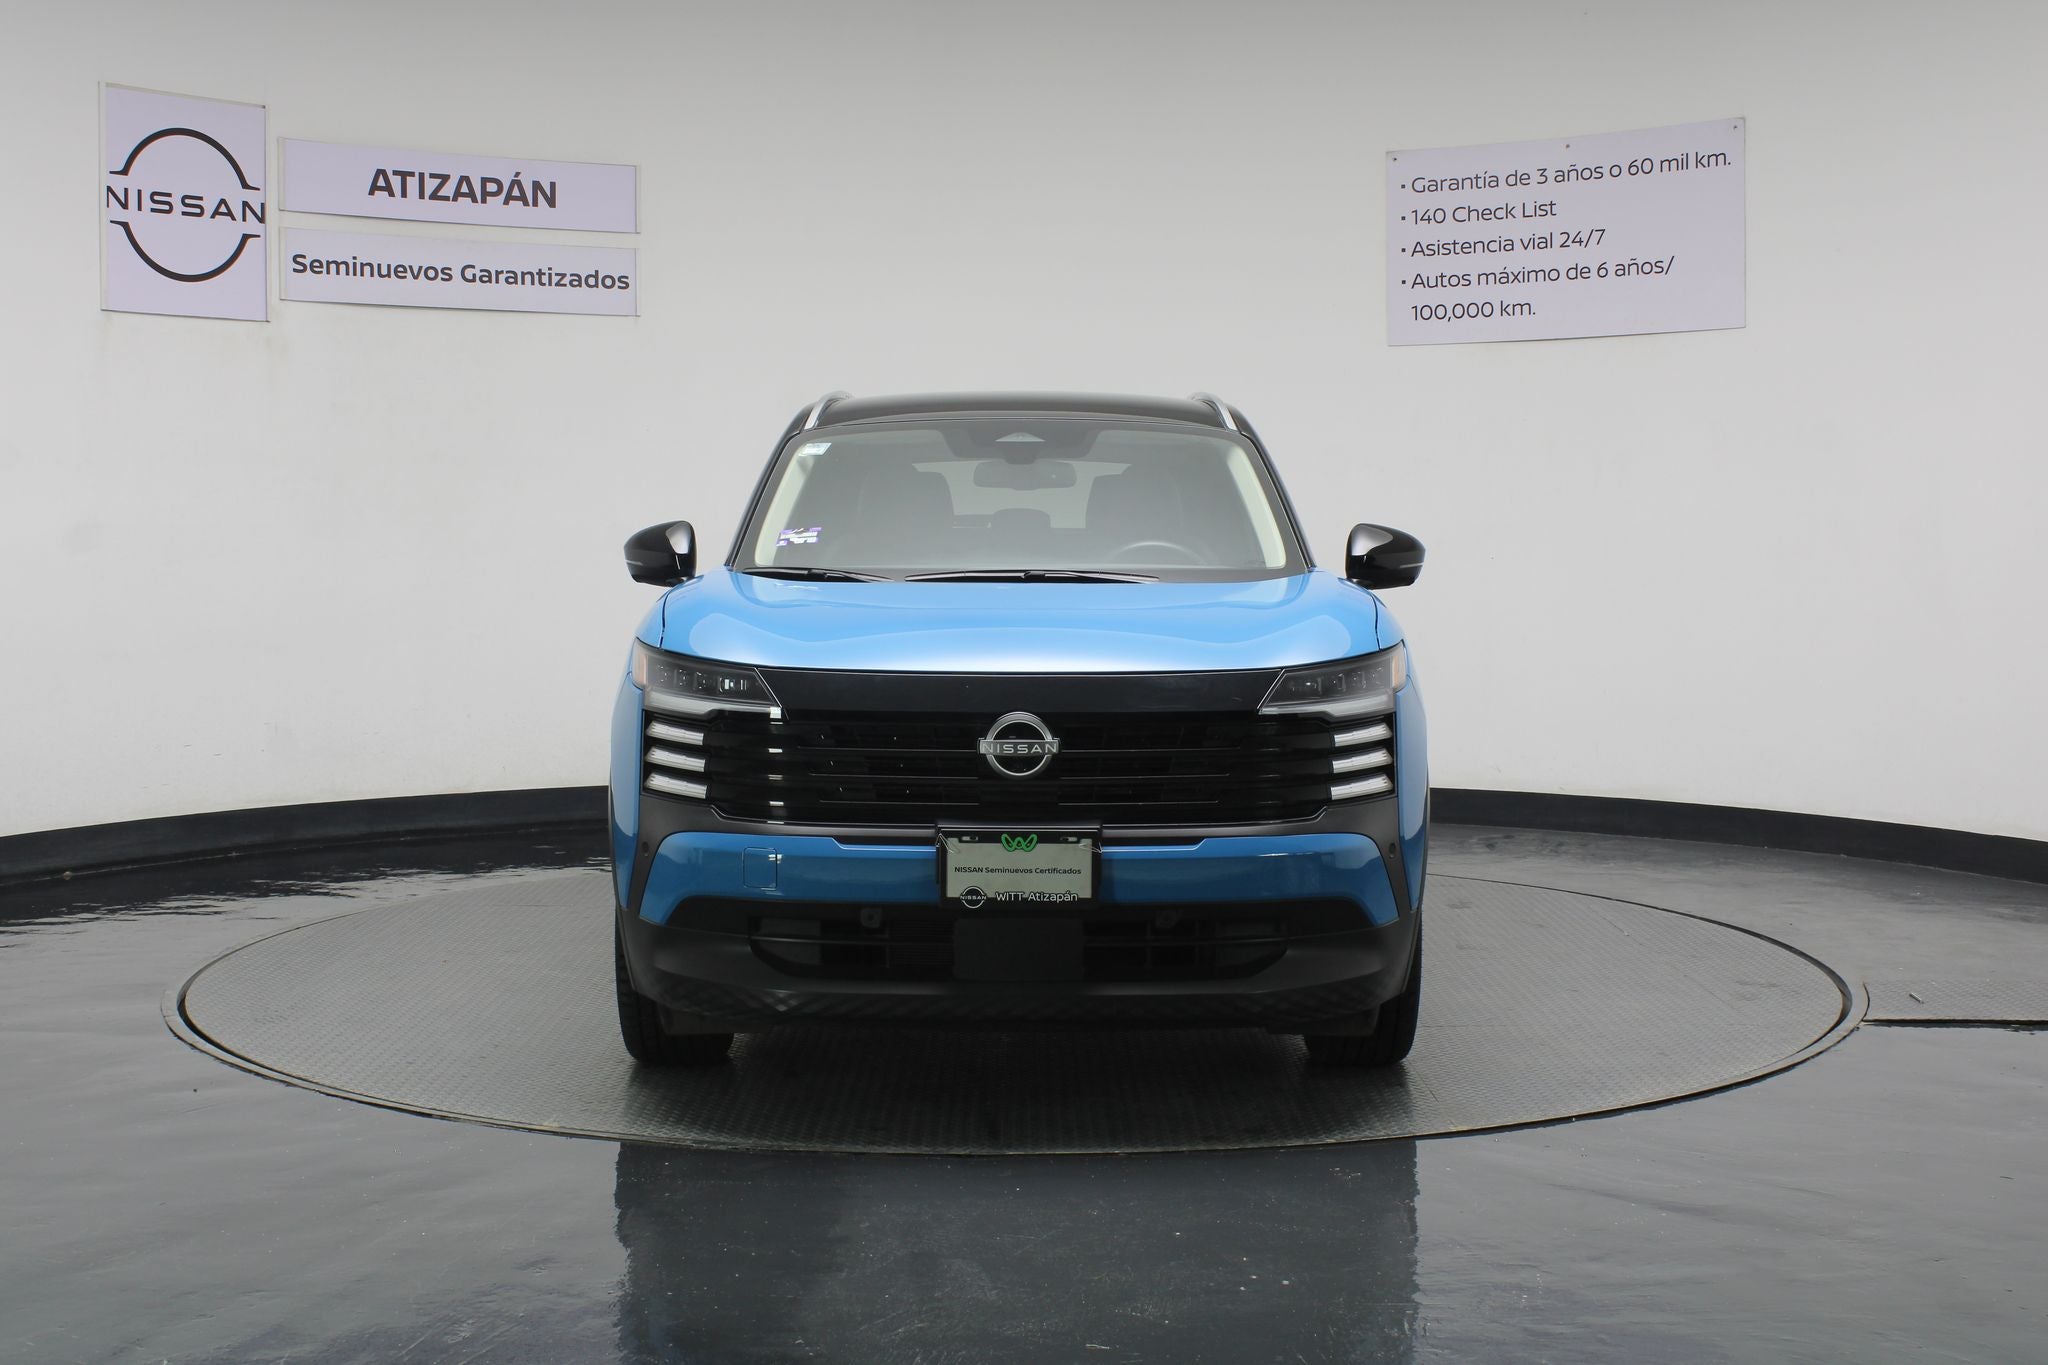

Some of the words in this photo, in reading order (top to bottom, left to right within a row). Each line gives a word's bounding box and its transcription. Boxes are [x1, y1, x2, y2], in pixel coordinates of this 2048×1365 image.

[1410, 170, 1500, 194] Garantía
[1505, 168, 1532, 187] de
[1536, 167, 1549, 185] 3
[1553, 162, 1604, 184] años
[1608, 164, 1623, 178] o
[1626, 157, 1655, 177] 60
[1659, 152, 1690, 173] mil
[1694, 149, 1732, 168] km.
[367, 168, 558, 209] ATIZAPÁN
[106, 185, 266, 225] NISSAN
[1411, 207, 1448, 226] 140
[1451, 202, 1517, 224] Check
[1521, 200, 1558, 219] List
[1410, 236, 1515, 258] Asistencia
[1519, 231, 1554, 251] vial
[1558, 228, 1607, 250] 24/7
[291, 253, 454, 283] Seminuevos
[460, 263, 630, 290] Garantizados
[1410, 271, 1473, 290] Autos
[1476, 265, 1561, 286] máximo
[1565, 262, 1592, 281] de
[1595, 261, 1610, 280] 6
[1613, 255, 1676, 278] años/
[1410, 301, 1495, 323] 100,000
[1499, 299, 1537, 318] km.
[980, 743, 1058, 754] NISSAN
[954, 866, 984, 874] NISSAN
[984, 866, 1034, 875] Seminuevos
[1034, 867, 1082, 876] Certificados
[995, 891, 1025, 902] WITT
[1028, 890, 1079, 903] Atizapán
